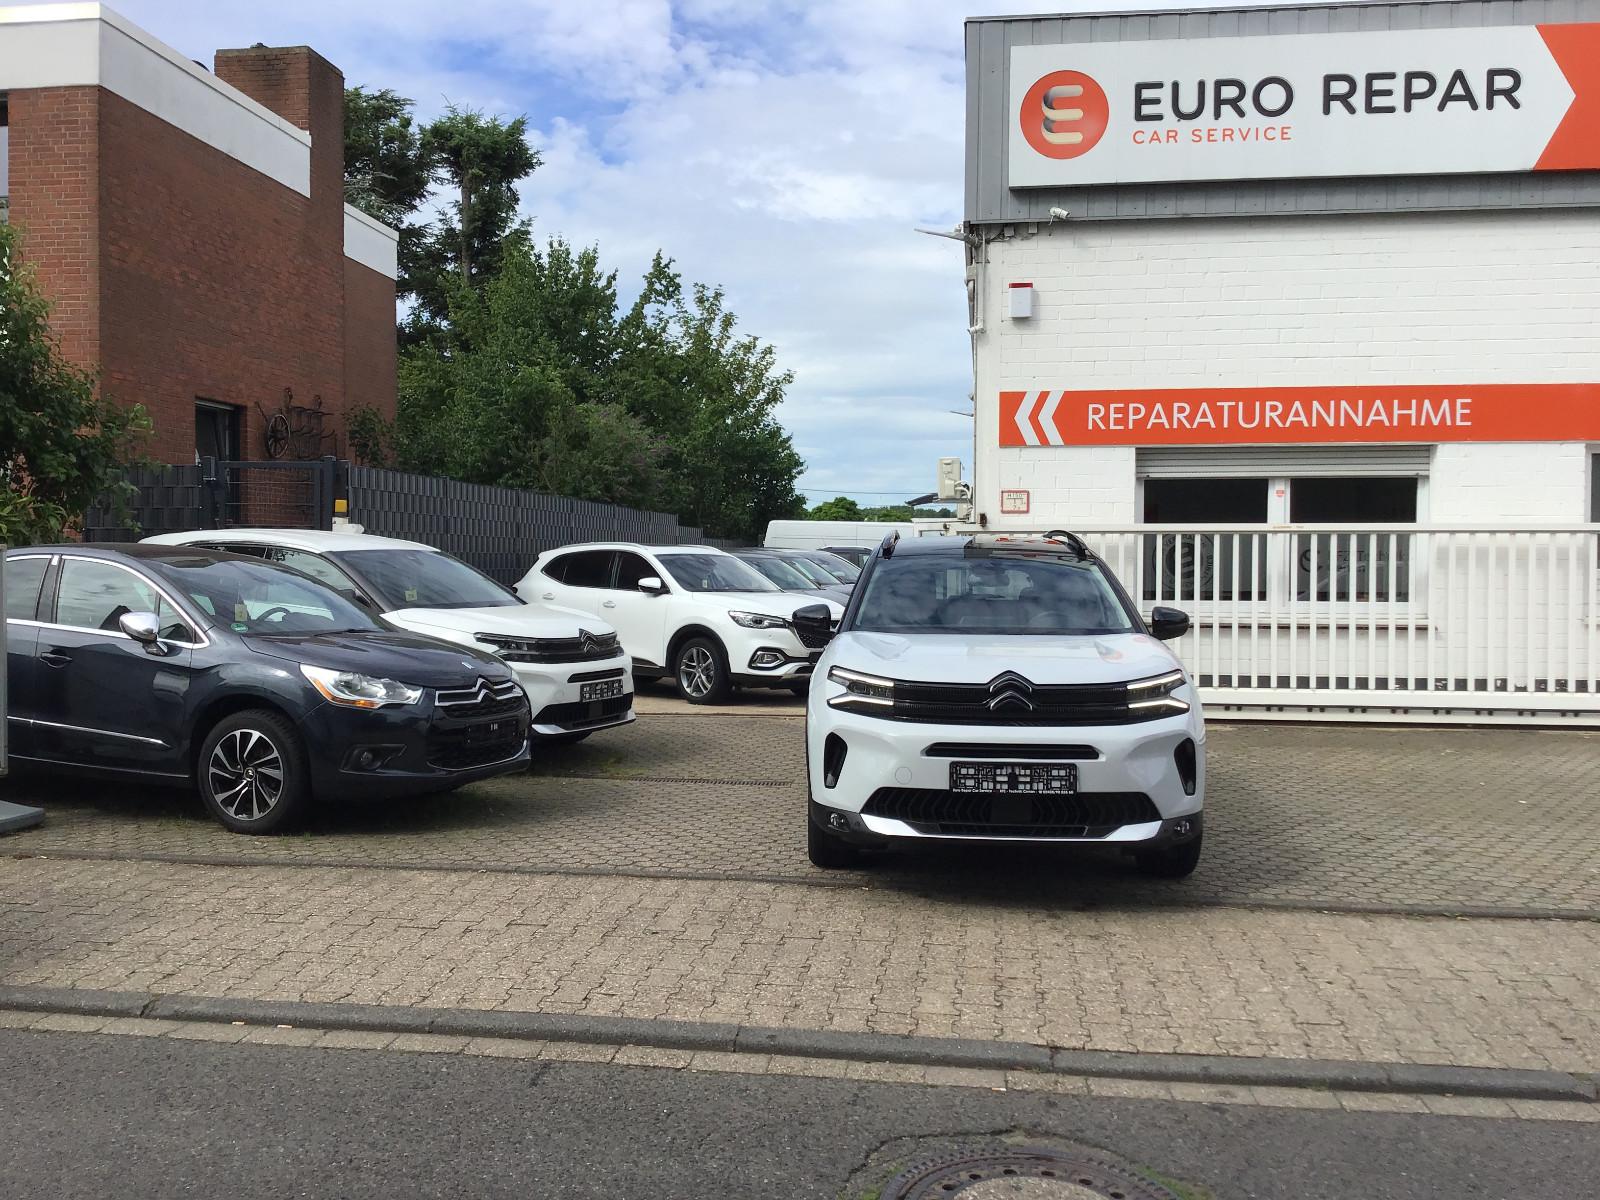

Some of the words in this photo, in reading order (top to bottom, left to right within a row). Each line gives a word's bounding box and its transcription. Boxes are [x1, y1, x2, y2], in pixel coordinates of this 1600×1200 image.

[1134, 75, 1294, 122] EURO
[1322, 67, 1522, 116] REPAR
[1132, 129, 1179, 144] CAR
[1191, 126, 1293, 142] SERVICE
[1087, 398, 1472, 431] REPARATURANNAHME
